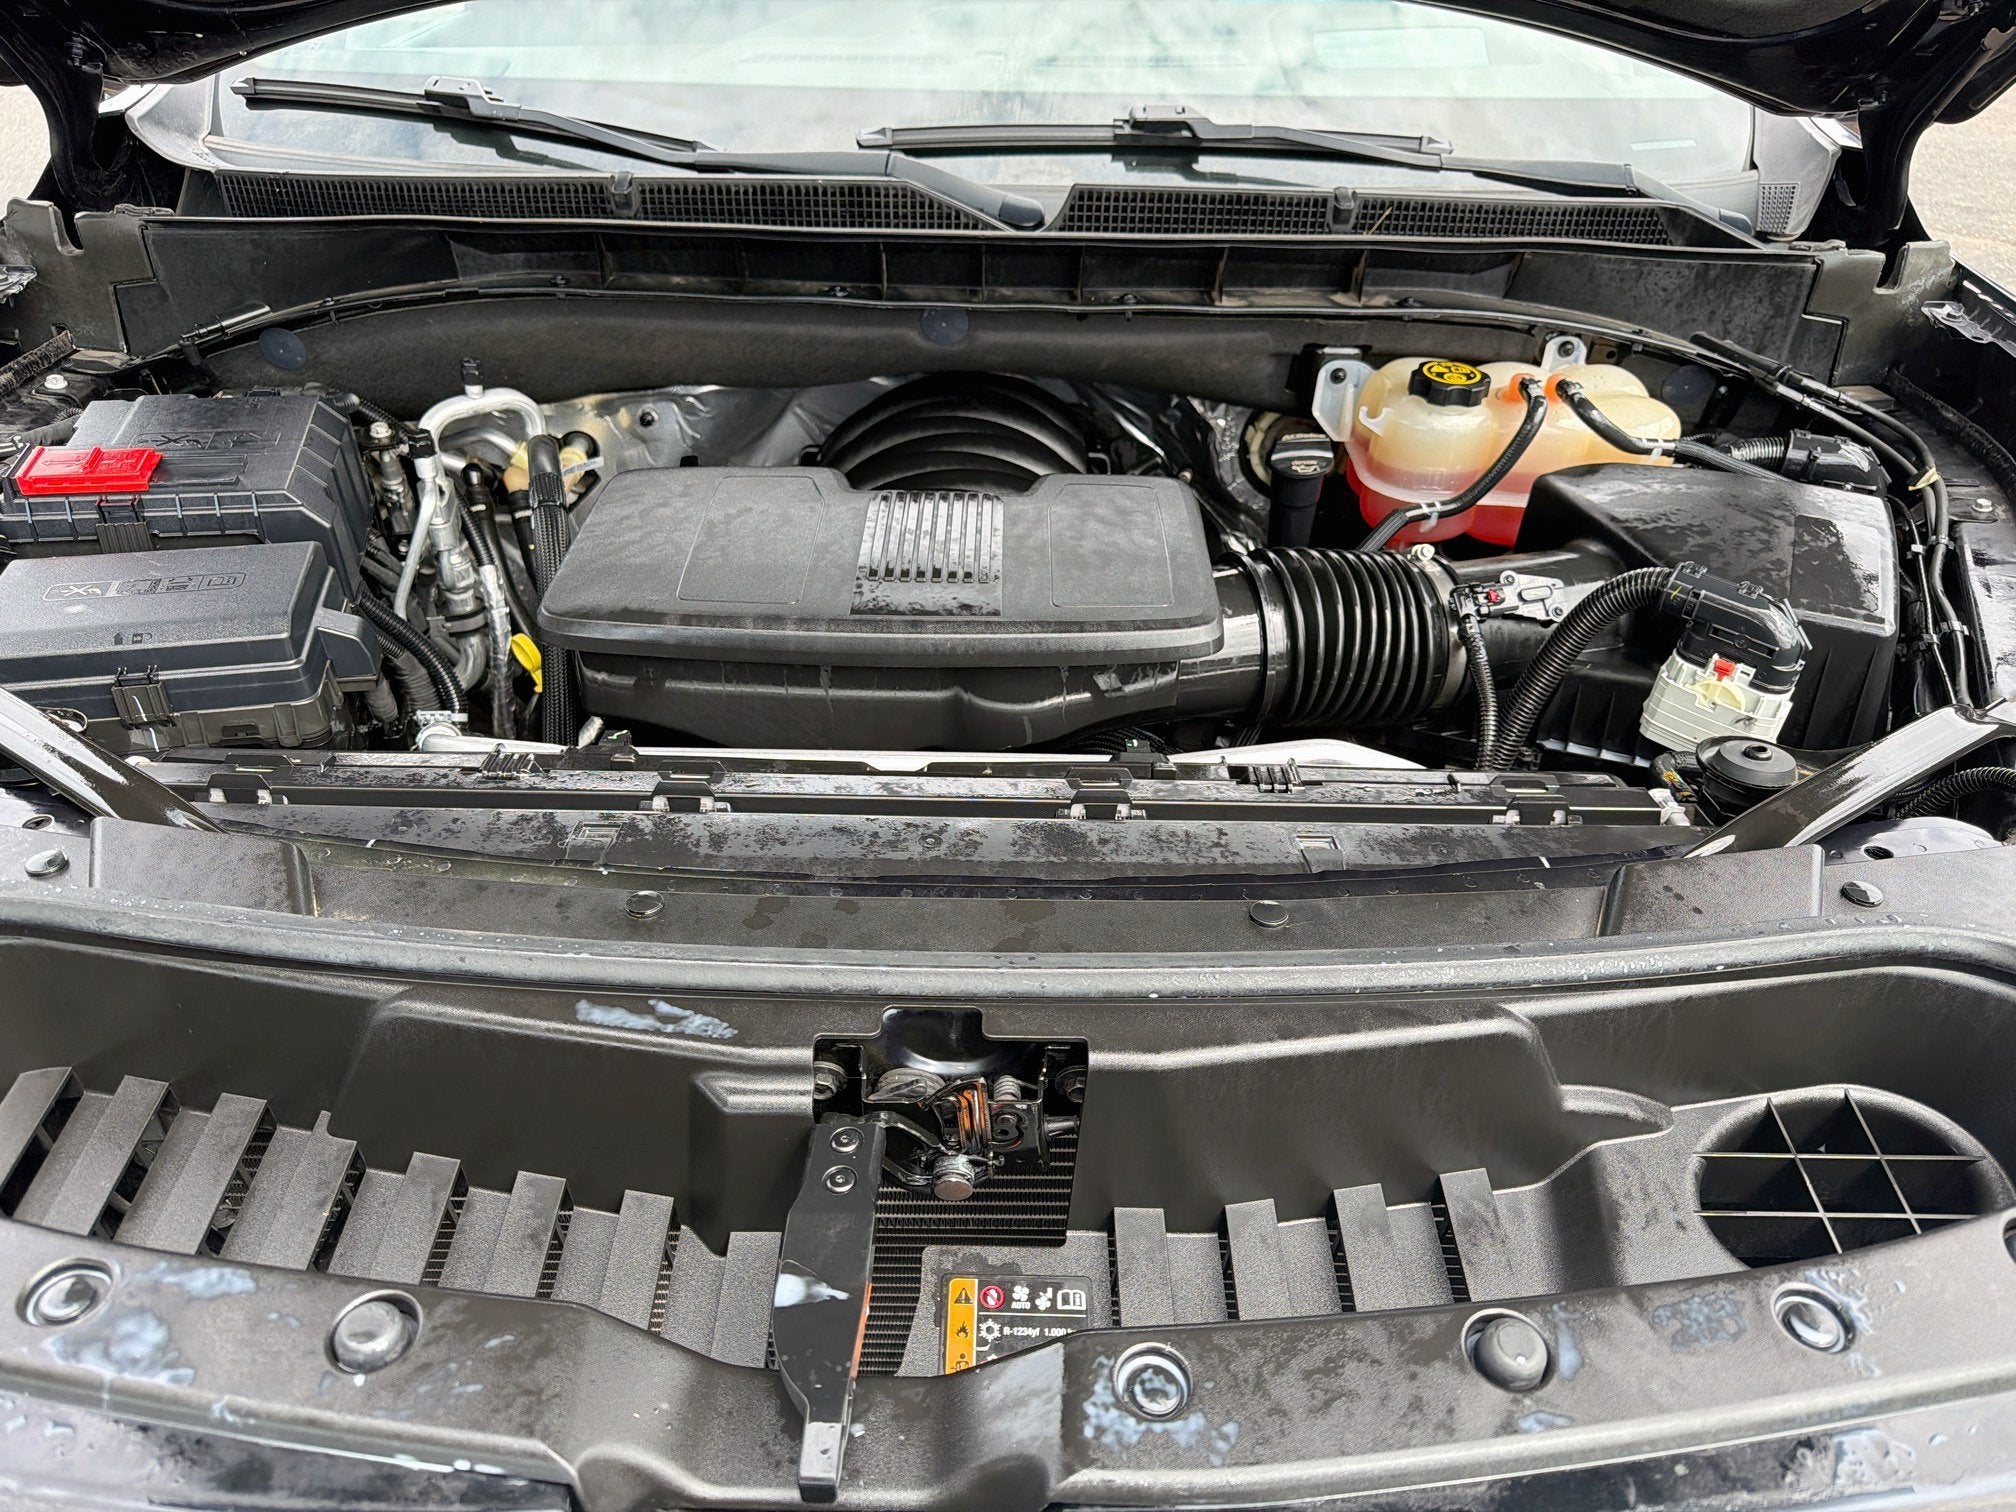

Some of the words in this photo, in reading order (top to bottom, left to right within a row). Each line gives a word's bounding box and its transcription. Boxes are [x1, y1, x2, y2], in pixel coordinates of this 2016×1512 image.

[1011, 1301, 1031, 1310] AUTO
[1003, 1326, 1040, 1337] R-1234yf
[1043, 1327, 1067, 1337] 1.000
